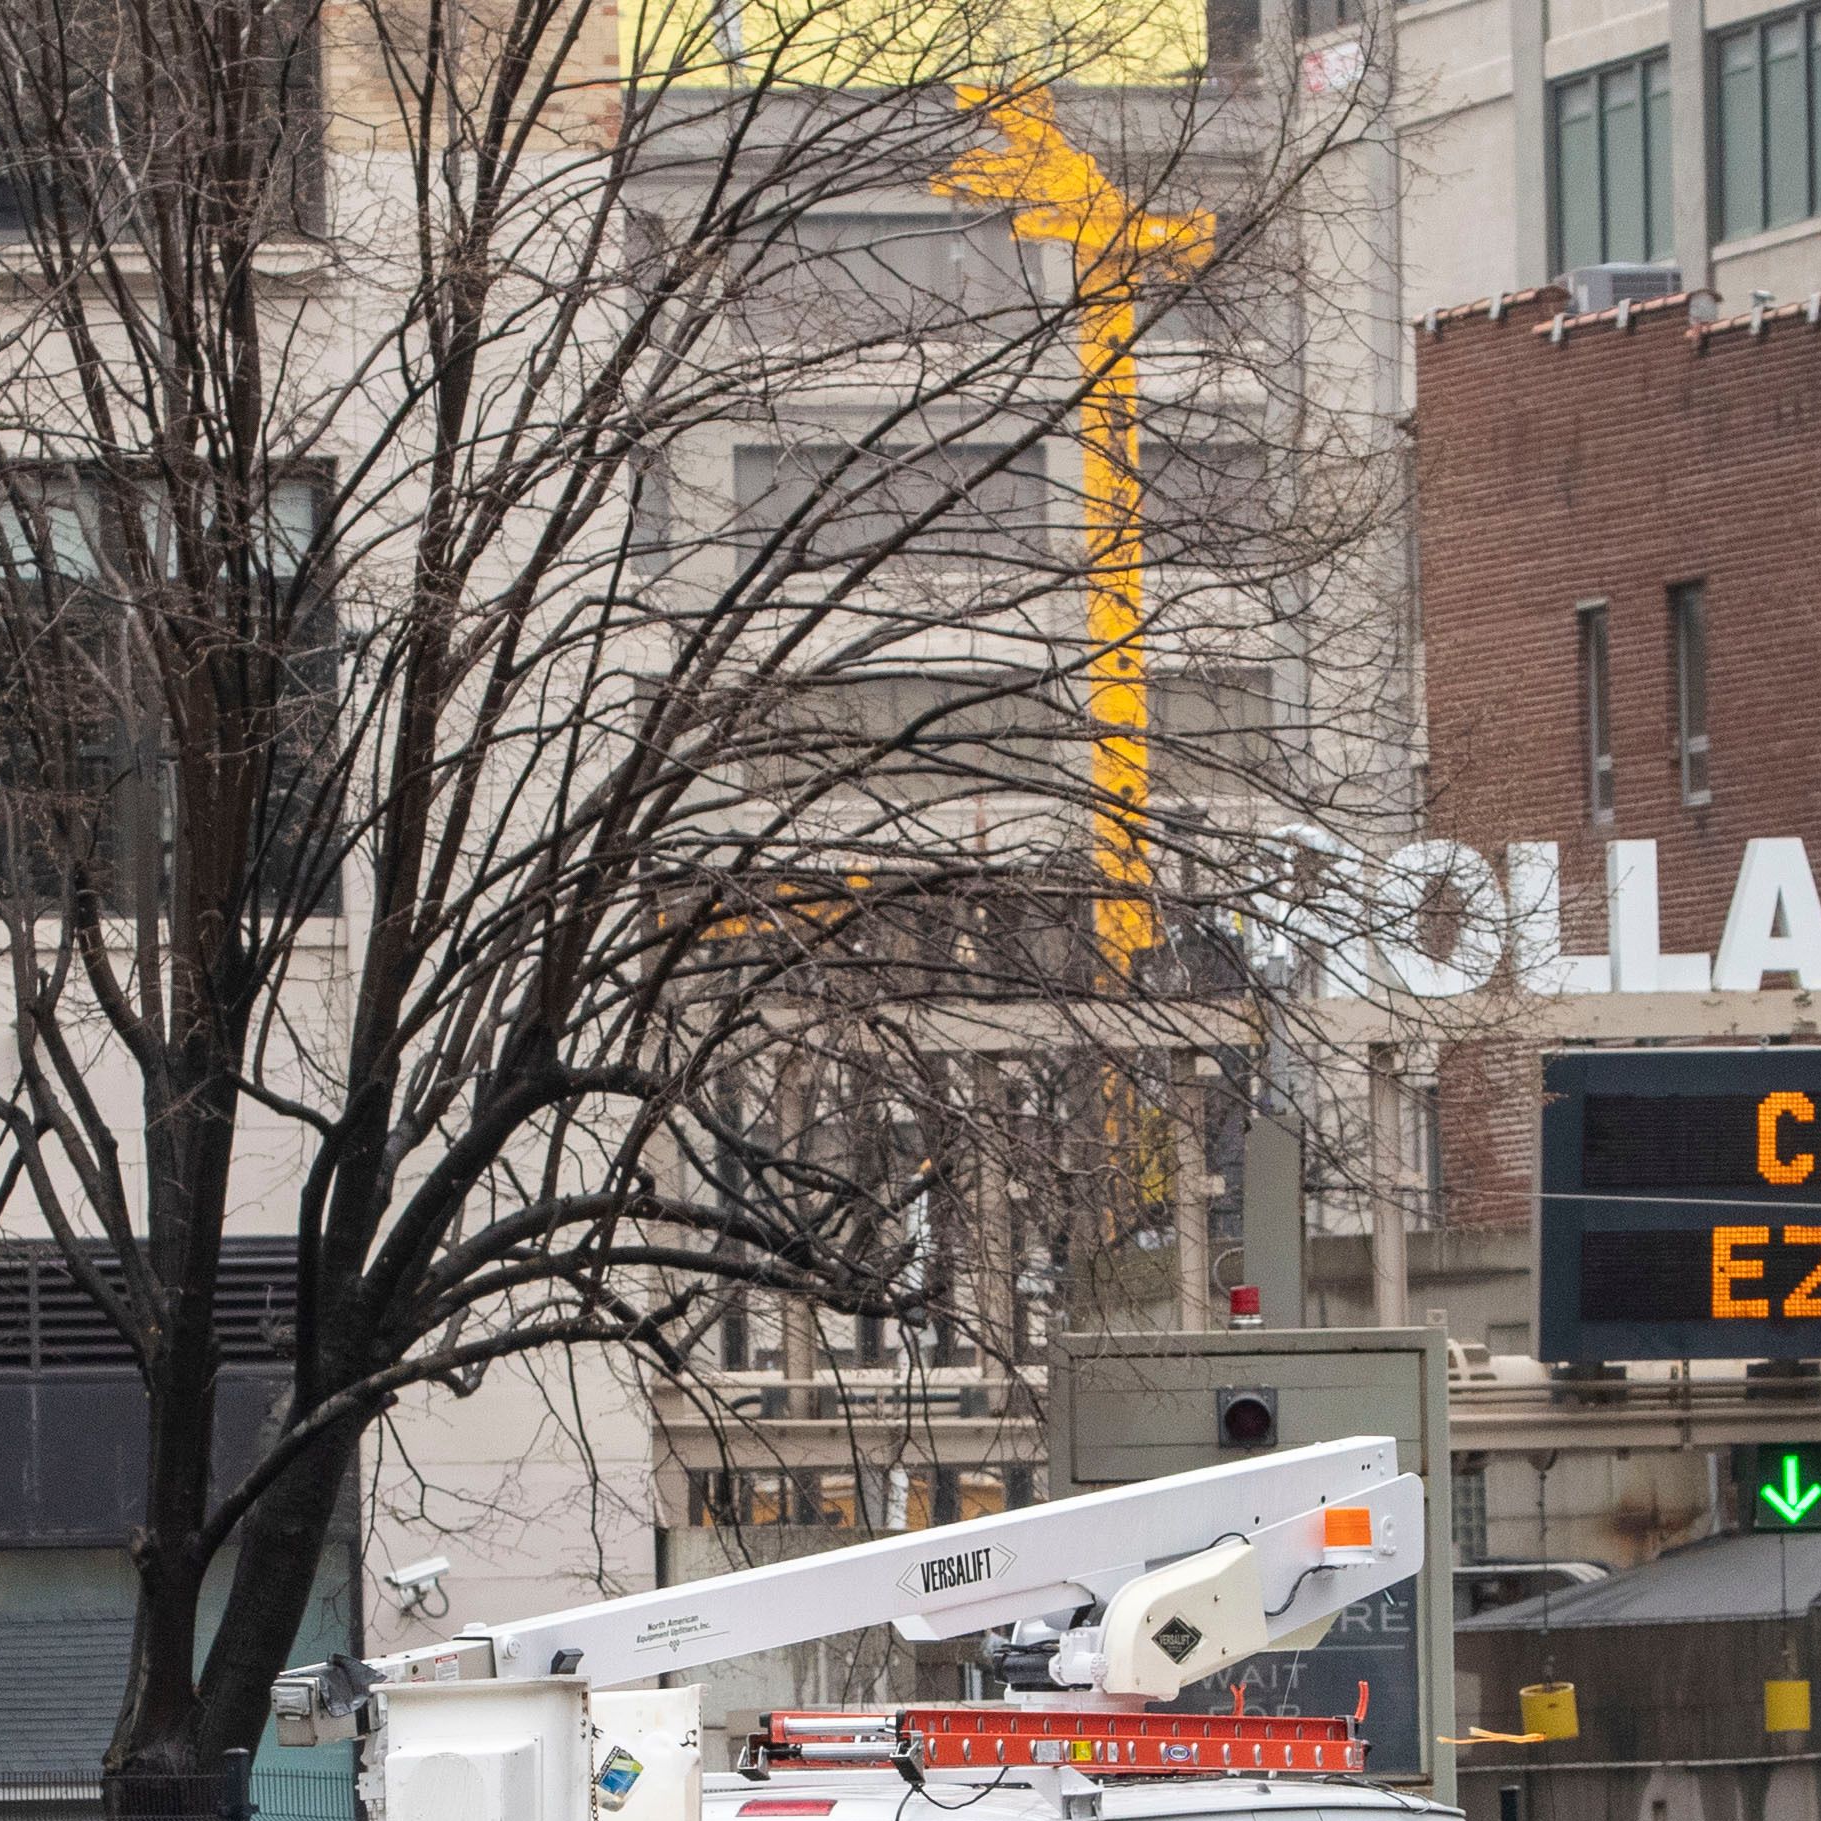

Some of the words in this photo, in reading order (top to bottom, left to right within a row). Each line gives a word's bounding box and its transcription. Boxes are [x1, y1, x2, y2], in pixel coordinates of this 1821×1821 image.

[920, 1547, 992, 1594] VERSALIFT
[647, 1621, 666, 1631] North
[667, 1615, 699, 1627] American
[1199, 1662, 1309, 1690] WAIT
